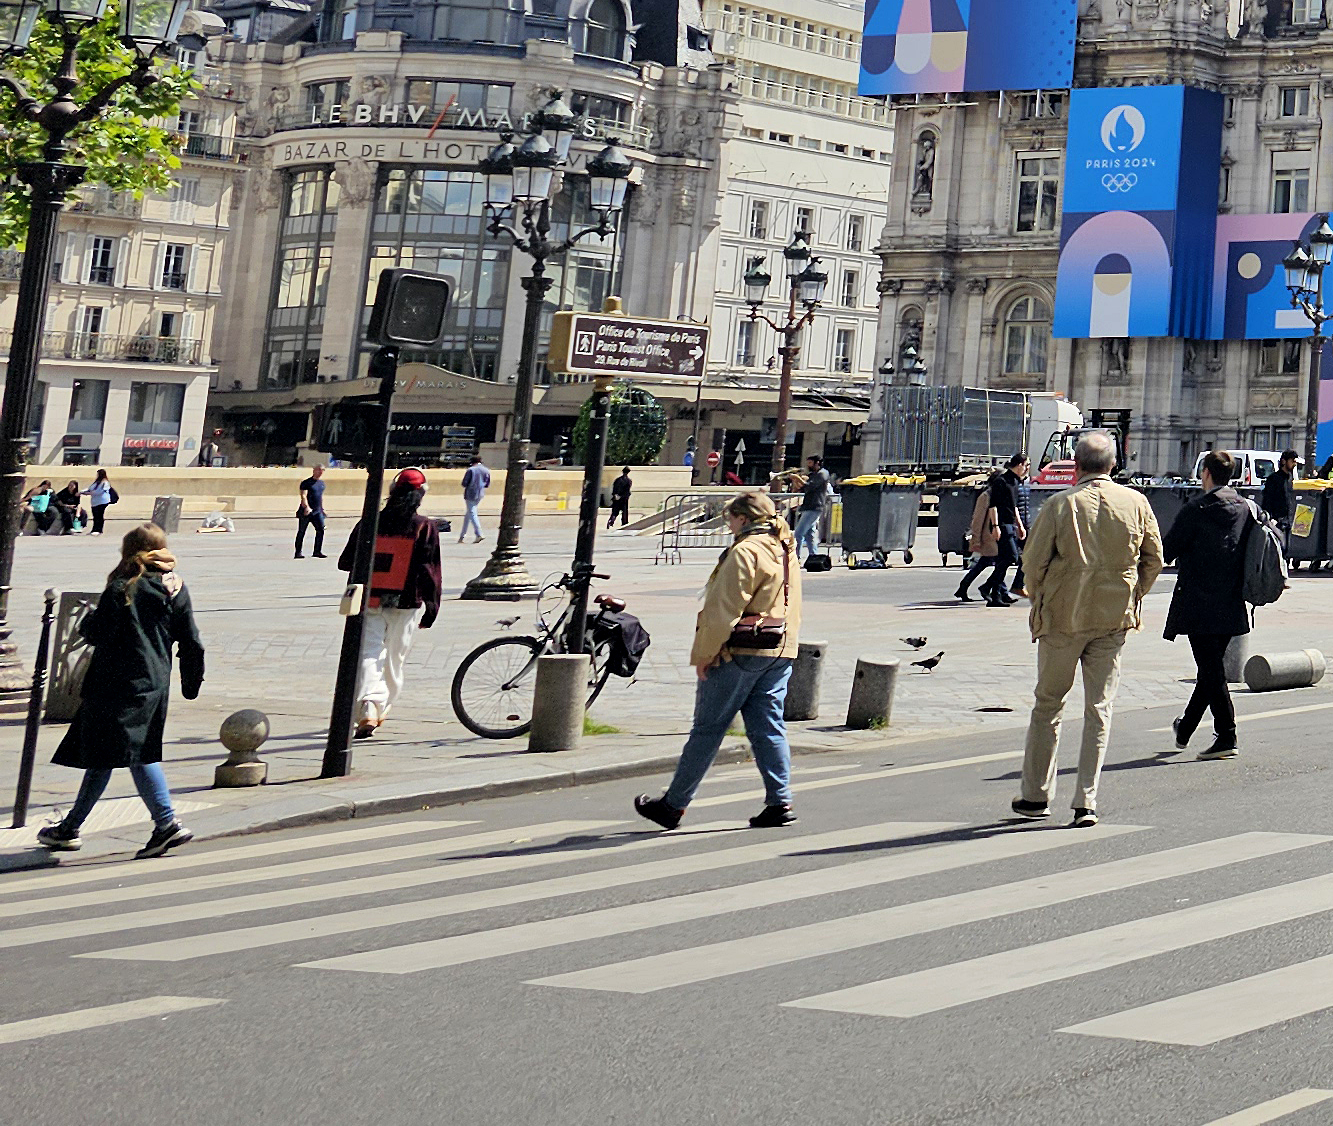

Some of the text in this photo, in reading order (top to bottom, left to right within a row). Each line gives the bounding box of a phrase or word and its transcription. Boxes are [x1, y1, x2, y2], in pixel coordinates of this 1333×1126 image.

[312, 104, 342, 124] LE
[354, 104, 427, 124] BHV
[285, 141, 349, 162] BAZAR
[361, 144, 386, 158] DE
[1085, 157, 1156, 169] PARIS 2024
[599, 324, 701, 344] Office de Tourisme de Paris
[596, 340, 670, 356] Paris Tourist Office
[416, 380, 467, 389] MARAIS
